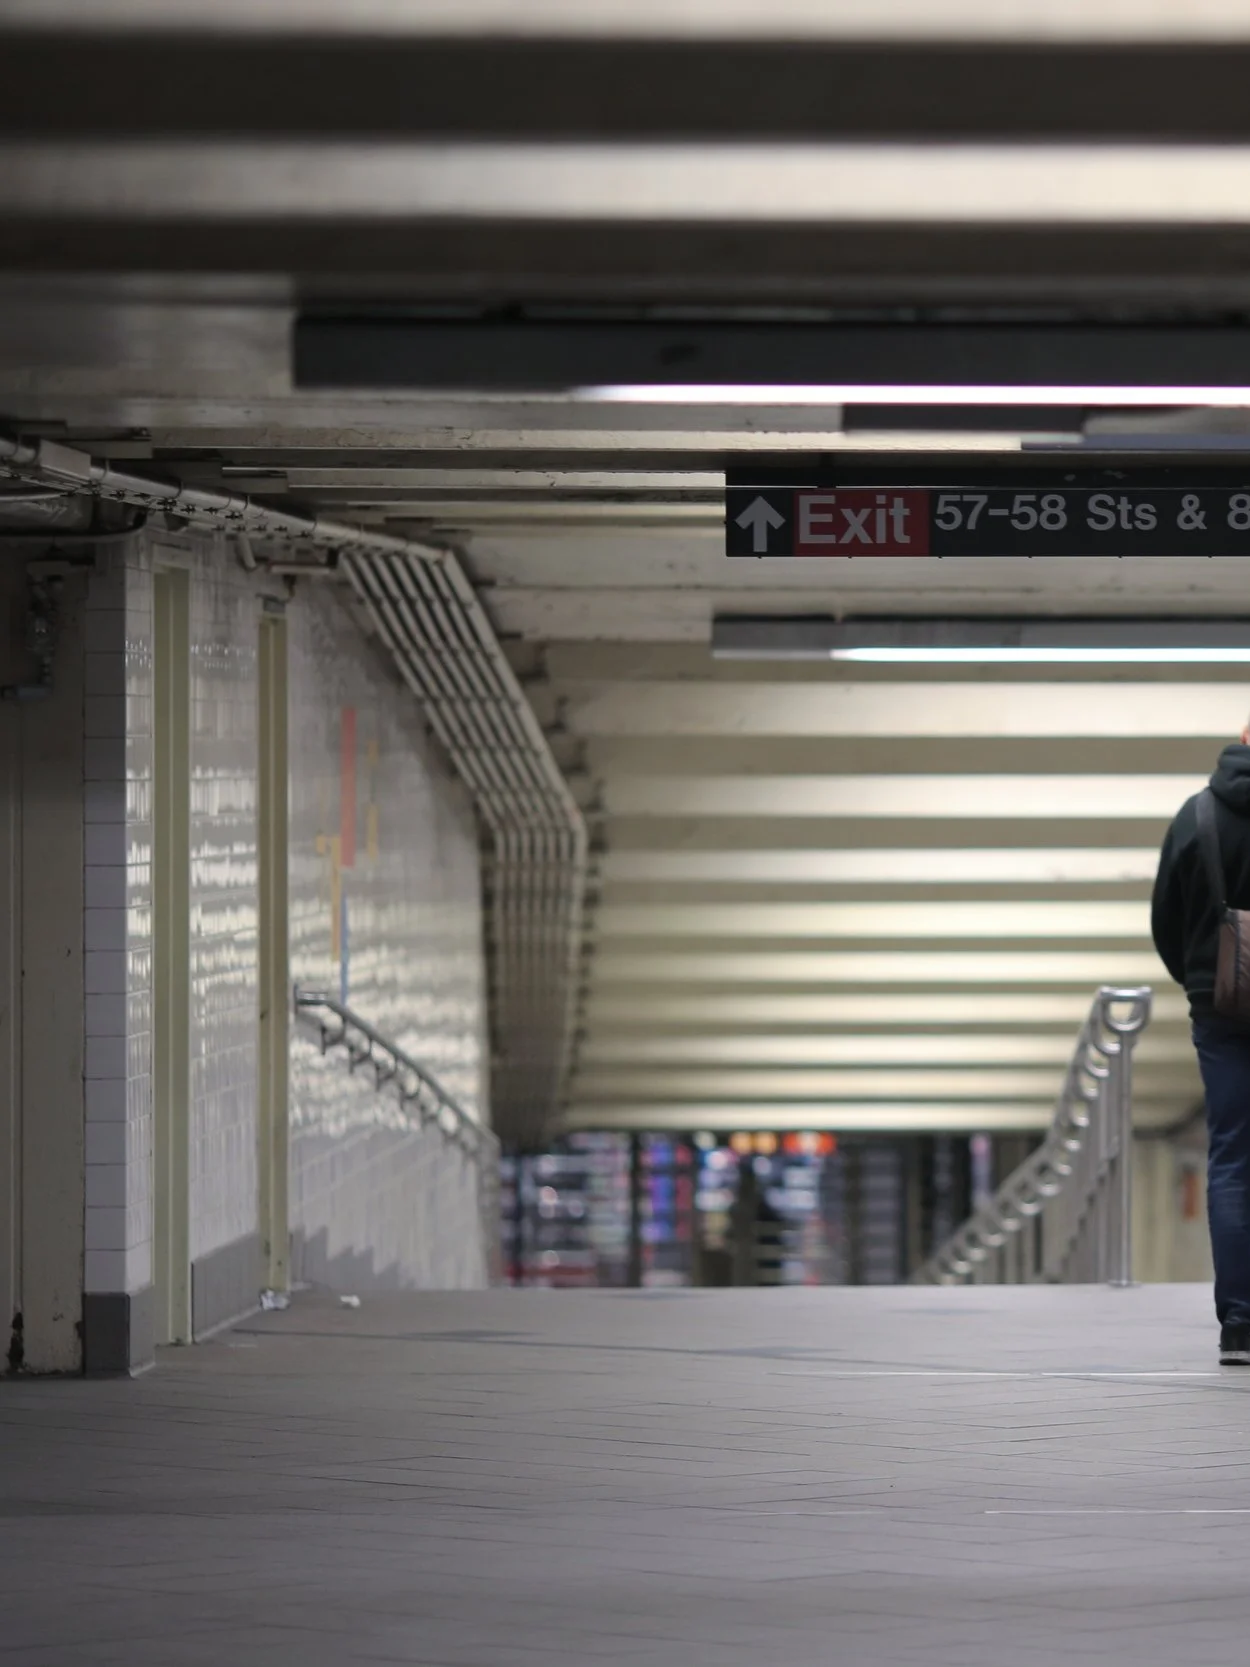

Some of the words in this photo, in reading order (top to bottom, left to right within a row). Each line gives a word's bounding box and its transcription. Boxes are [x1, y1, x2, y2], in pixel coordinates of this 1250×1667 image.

[799, 495, 911, 545] Exit
[934, 494, 1068, 531] 57-58
[1086, 494, 1158, 531] Sts
[1176, 494, 1208, 531] &
